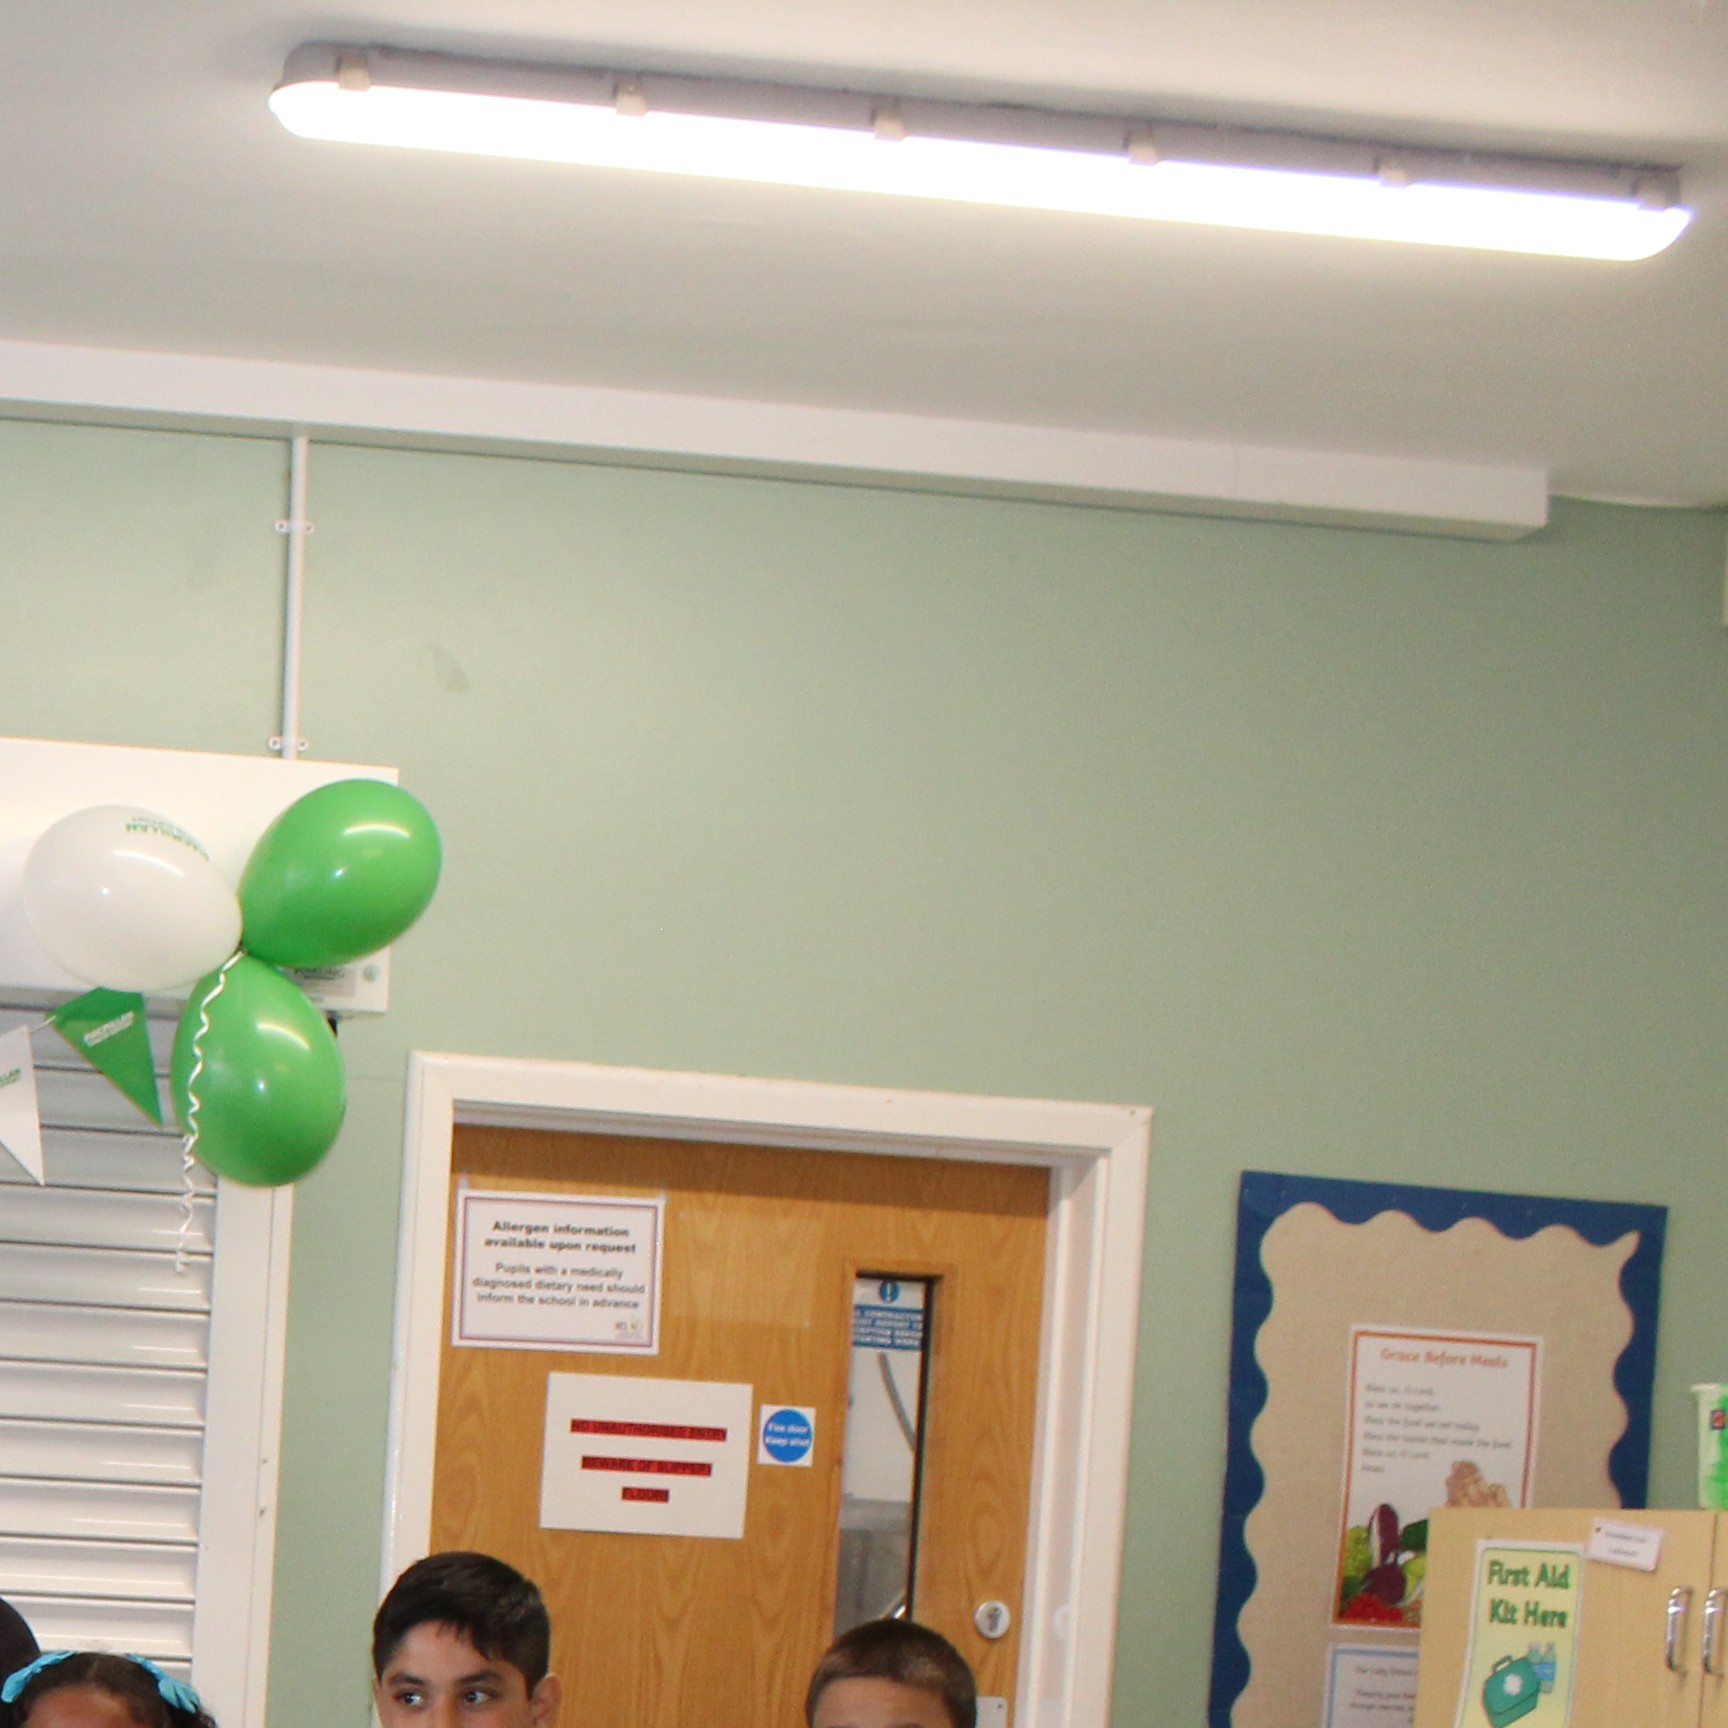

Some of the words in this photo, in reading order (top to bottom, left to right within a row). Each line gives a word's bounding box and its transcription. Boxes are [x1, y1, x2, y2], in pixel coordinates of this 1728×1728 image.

[493, 1221, 549, 1235] Allergen
[553, 1223, 629, 1237] information
[484, 1238, 544, 1249] available
[549, 1242, 581, 1253] upon
[585, 1243, 636, 1256] request
[1488, 1560, 1530, 1587] First
[1535, 1563, 1571, 1590] Aid
[1489, 1599, 1518, 1626] Kit
[1524, 1601, 1568, 1628] Here
